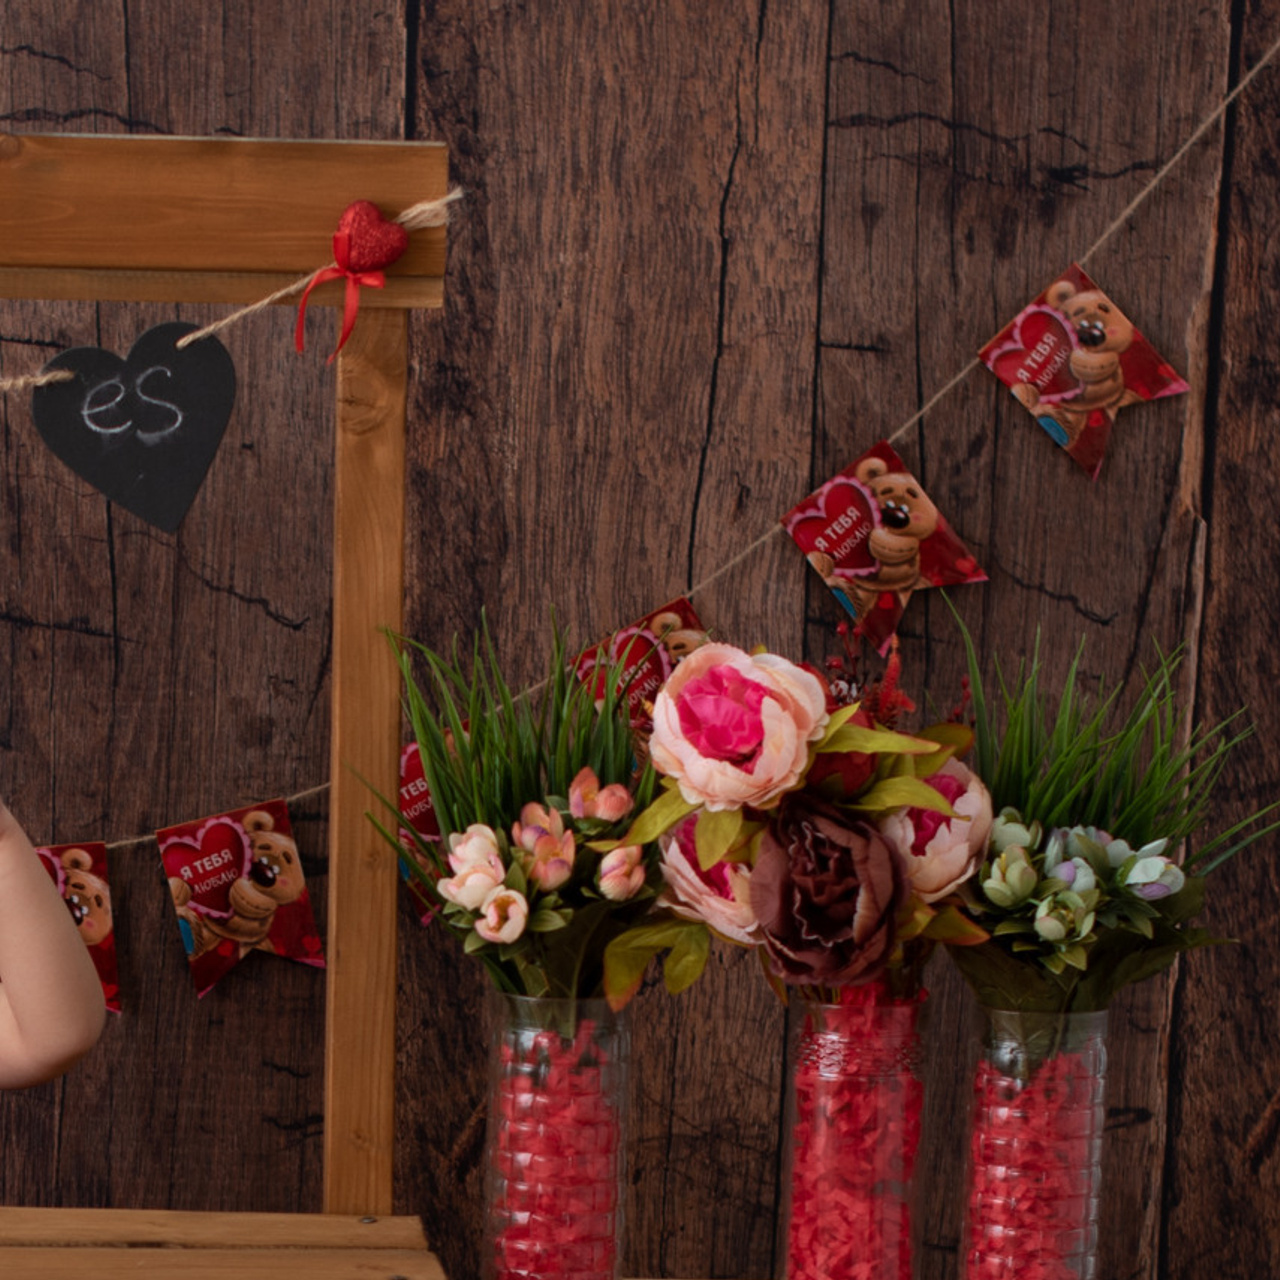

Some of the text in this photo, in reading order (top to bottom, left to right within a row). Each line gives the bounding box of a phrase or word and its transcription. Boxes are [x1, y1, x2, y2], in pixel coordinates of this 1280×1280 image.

[1016, 332, 1058, 382] Я ТЕБЯ
[814, 505, 862, 551] Я ТЕБЯ
[400, 777, 428, 801] ТЕБ
[180, 848, 234, 881] Я ТЕБЯ
